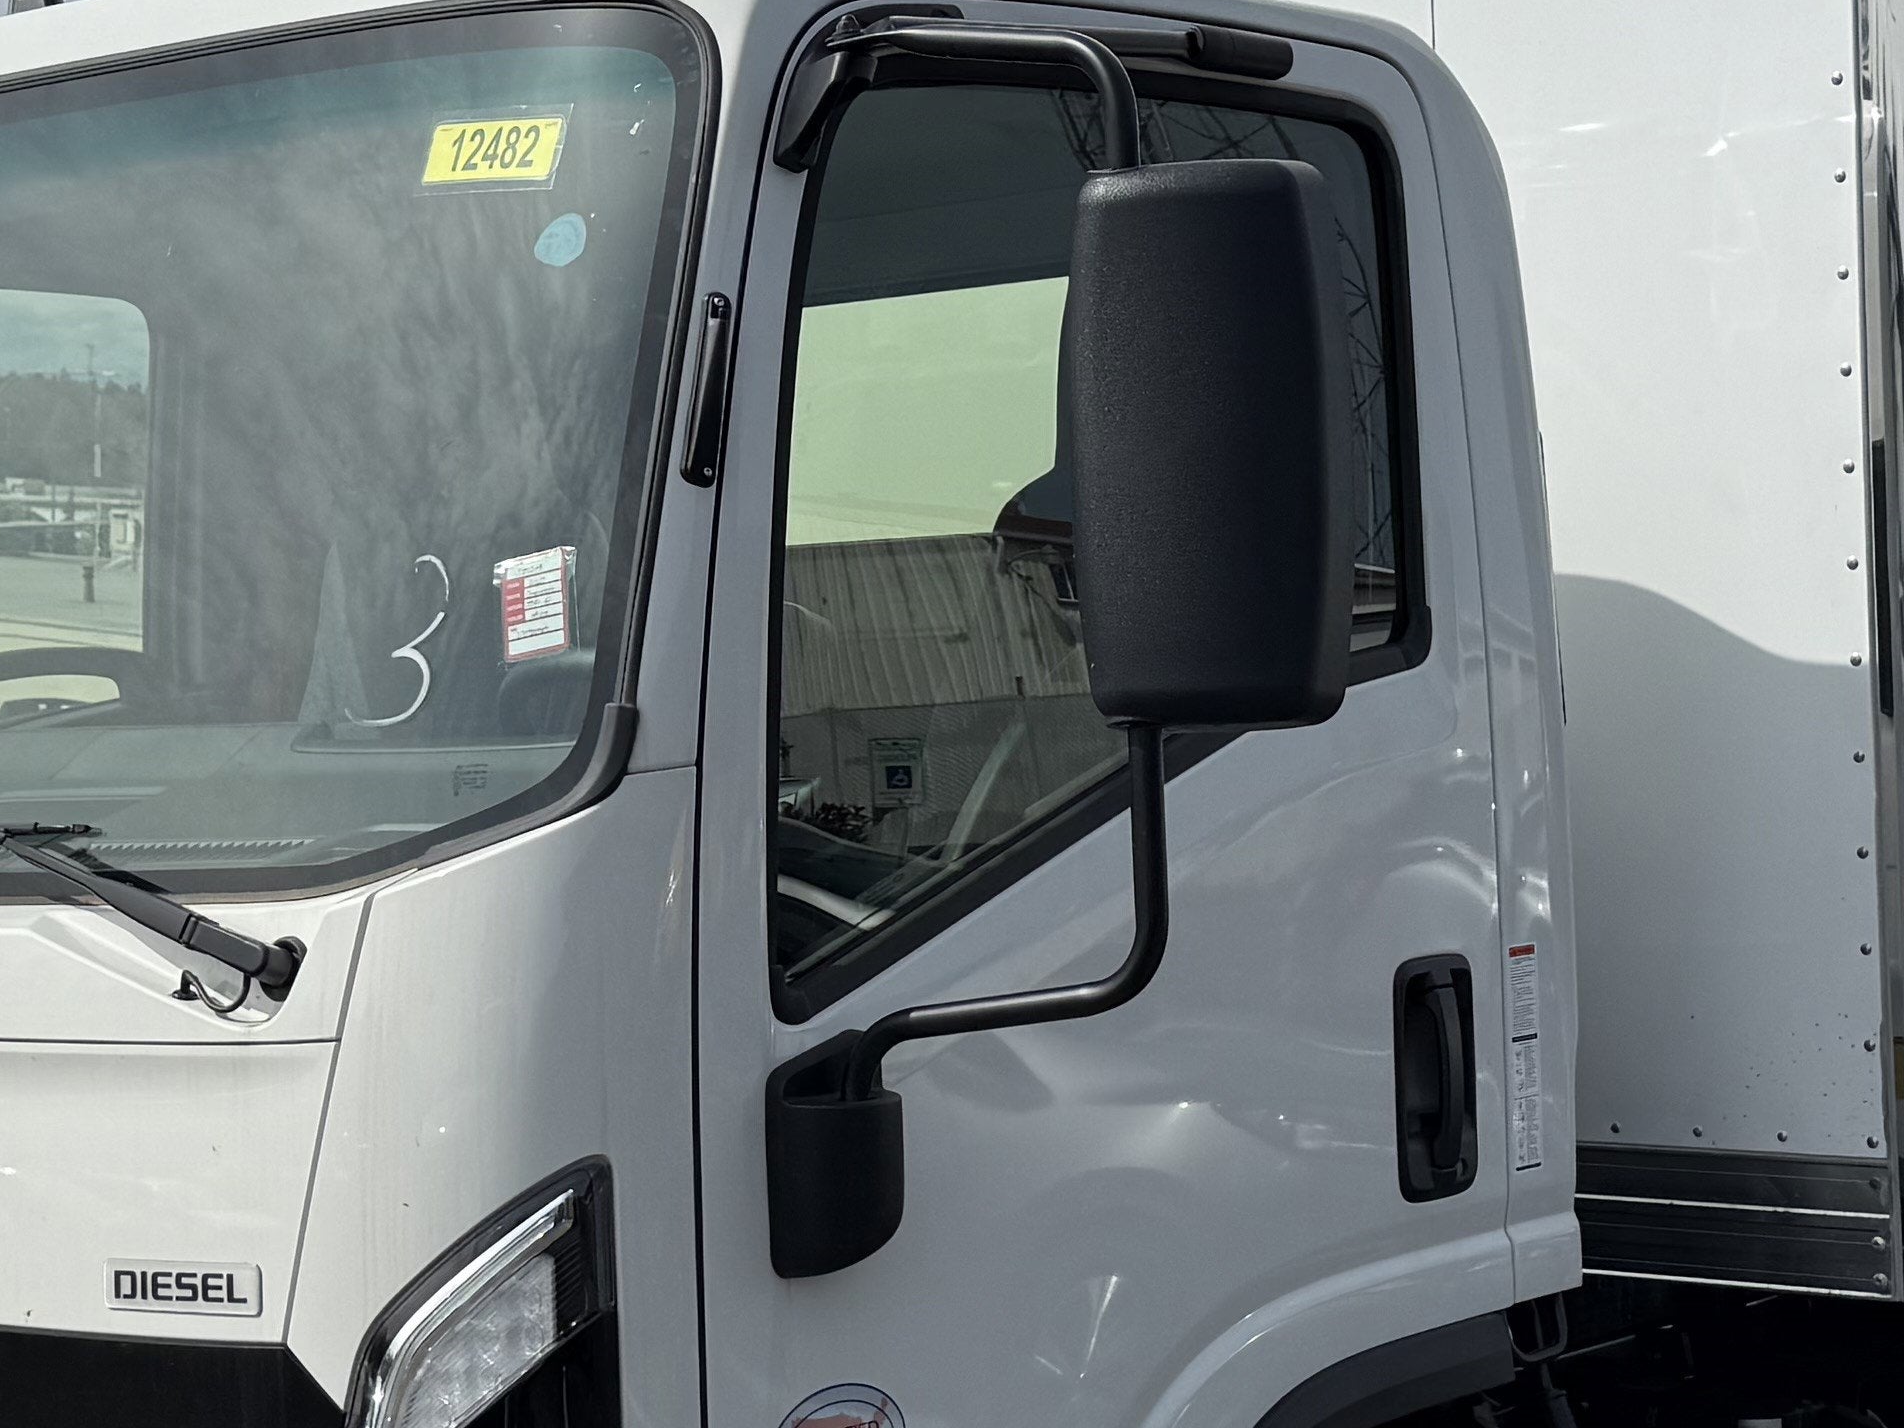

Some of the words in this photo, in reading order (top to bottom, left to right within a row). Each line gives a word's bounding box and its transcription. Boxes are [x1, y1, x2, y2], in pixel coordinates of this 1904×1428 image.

[451, 125, 541, 172] 12482
[344, 554, 449, 728] 3
[113, 1269, 248, 1304] DIESEL
